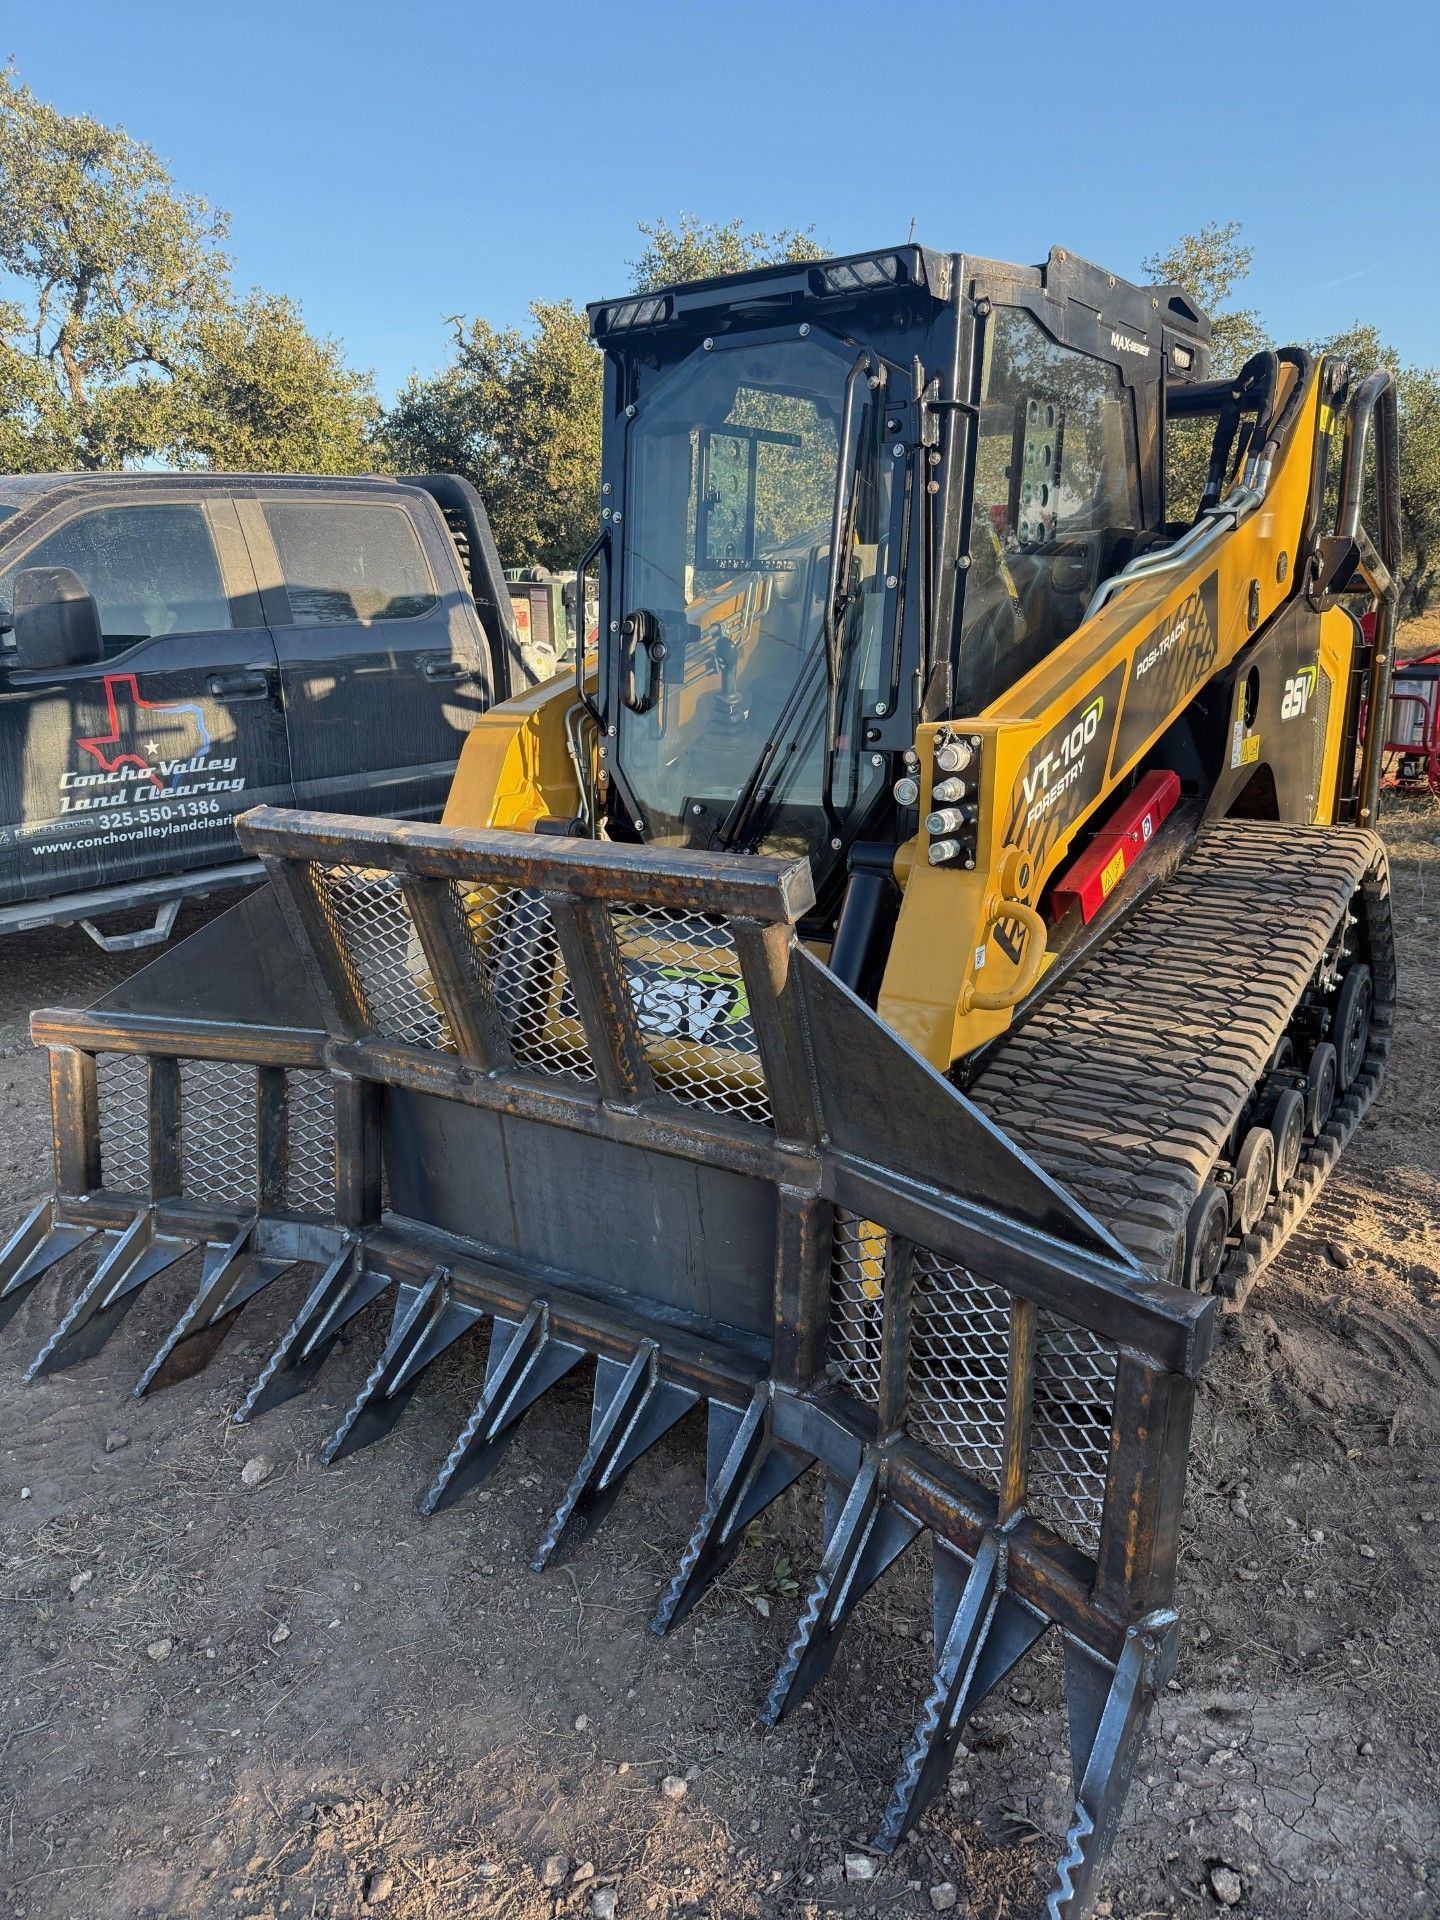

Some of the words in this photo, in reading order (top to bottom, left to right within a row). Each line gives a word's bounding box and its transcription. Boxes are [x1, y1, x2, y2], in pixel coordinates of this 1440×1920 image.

[1136, 615, 1187, 681] POSI-TRACK
[60, 765, 156, 790] Concho
[159, 757, 238, 776] Valley
[1022, 709, 1097, 804] VT-100
[60, 789, 128, 813] Land
[134, 777, 246, 801] Clearing
[99, 799, 221, 830] 325-550-1386
[1026, 755, 1086, 829] FORESTRY
